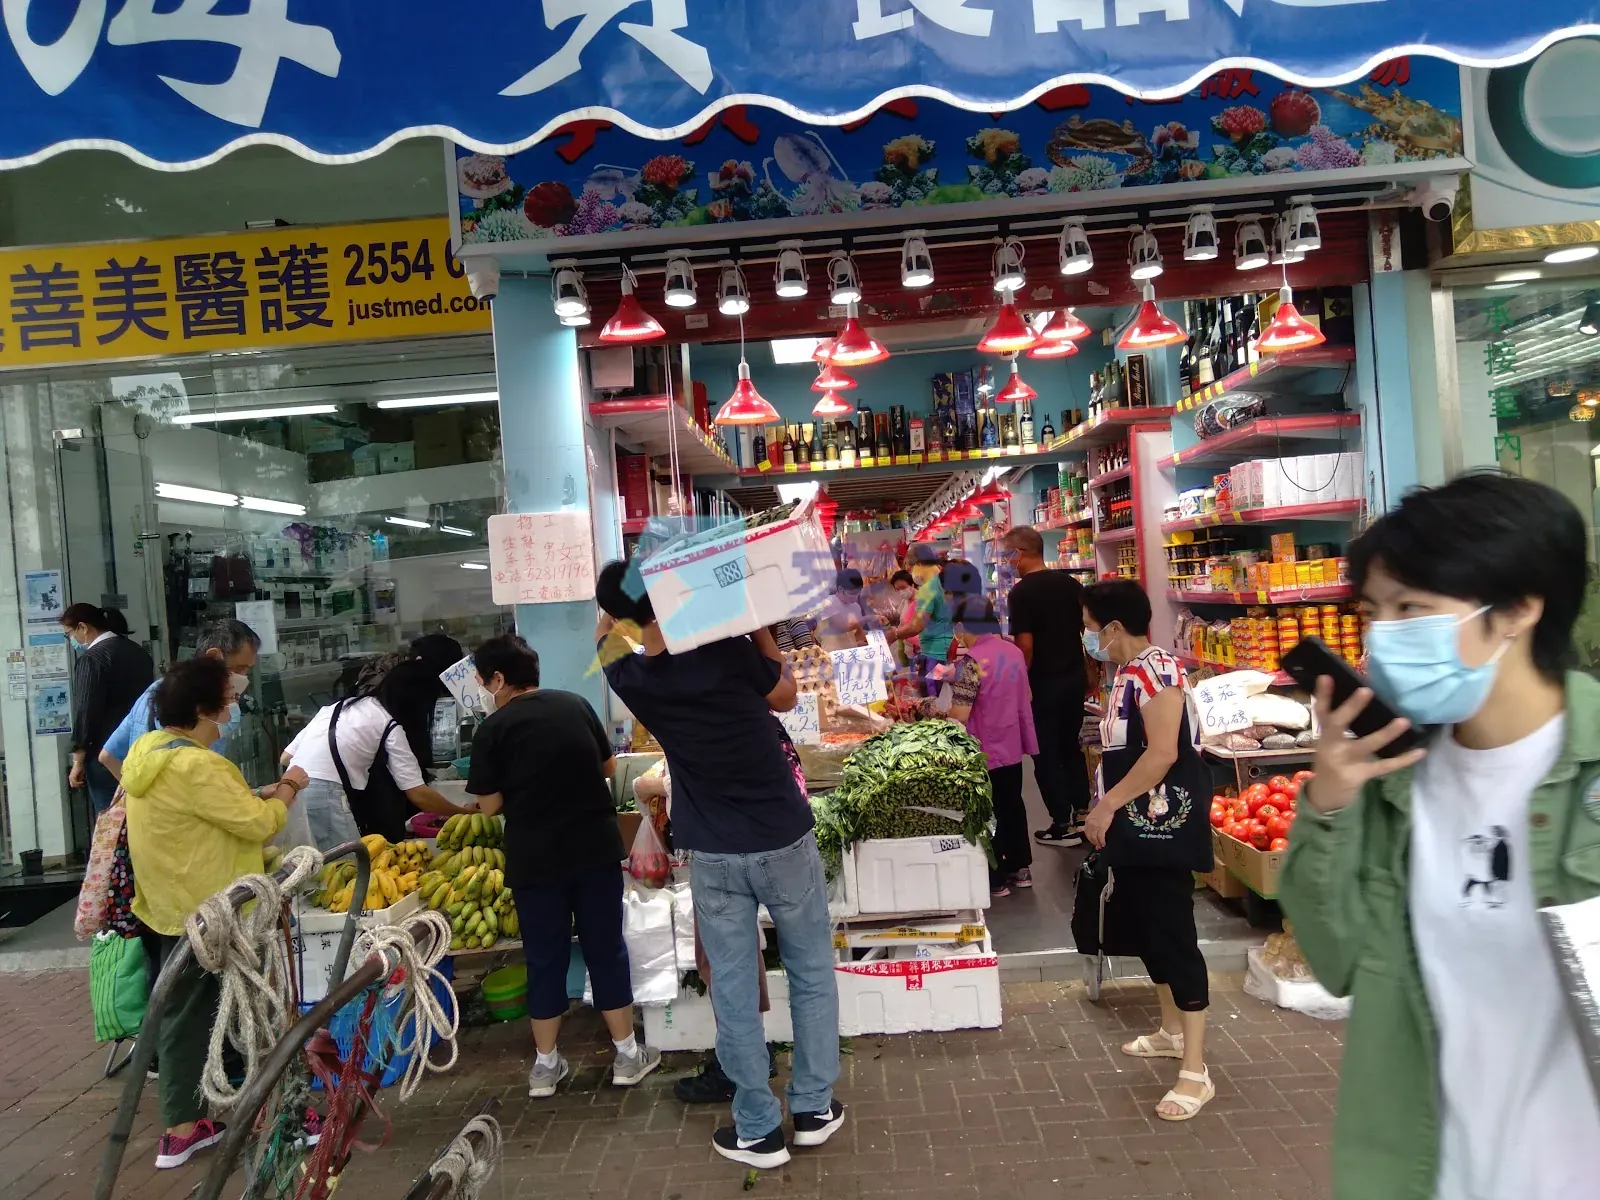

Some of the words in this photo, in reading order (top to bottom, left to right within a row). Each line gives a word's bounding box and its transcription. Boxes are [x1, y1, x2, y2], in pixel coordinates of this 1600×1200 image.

[0, 243, 334, 352] 善美醫護
[344, 239, 434, 286] 2554
